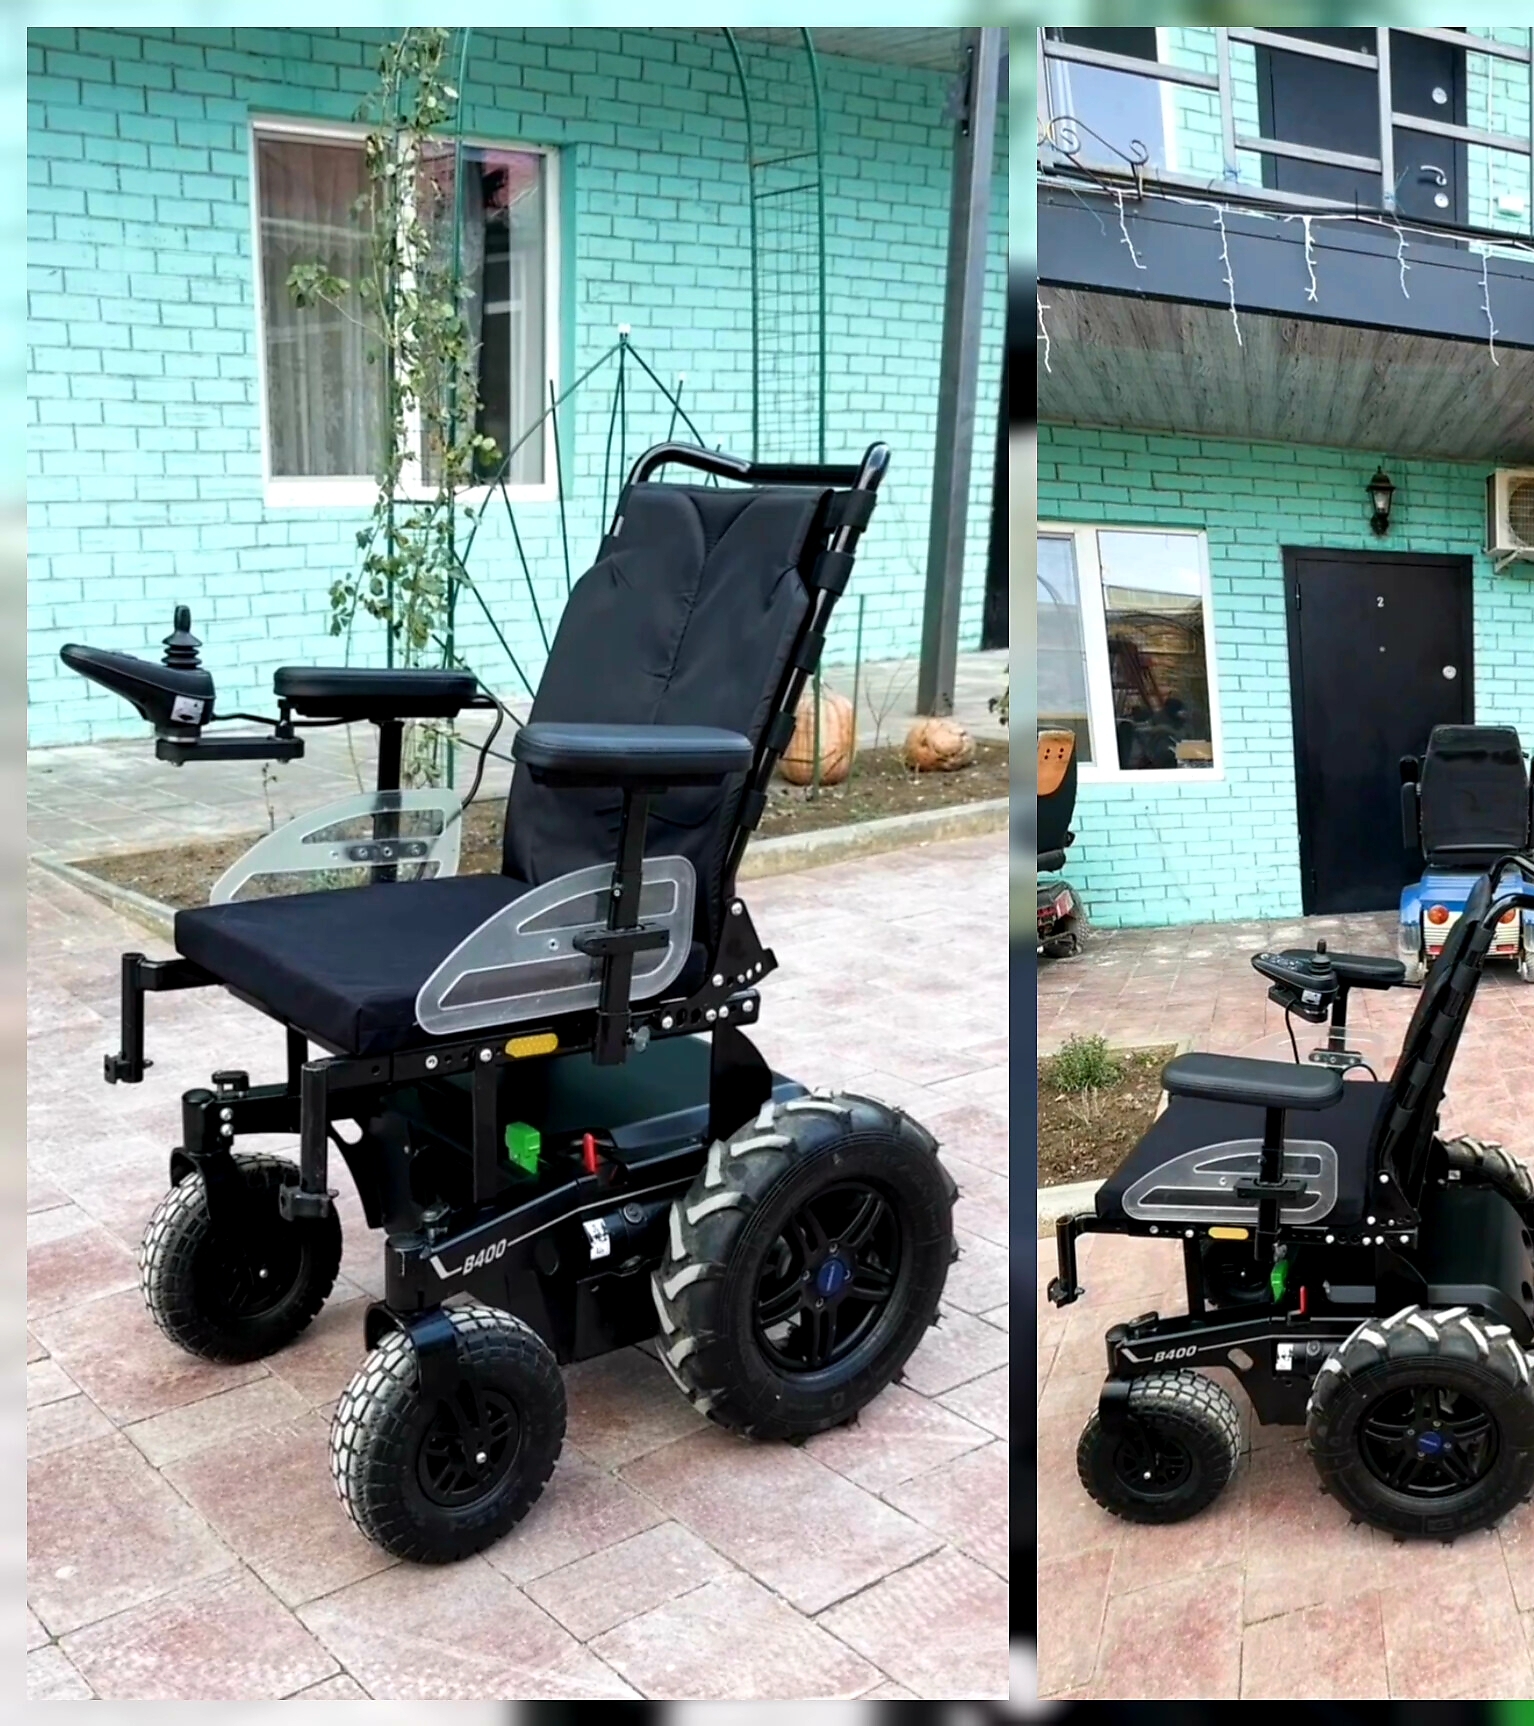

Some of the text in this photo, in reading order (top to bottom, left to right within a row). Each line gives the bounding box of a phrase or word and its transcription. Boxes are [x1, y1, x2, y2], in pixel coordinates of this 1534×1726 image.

[1376, 595, 1385, 608] 2
[461, 1238, 508, 1276] B400
[1153, 1344, 1198, 1364] B400
